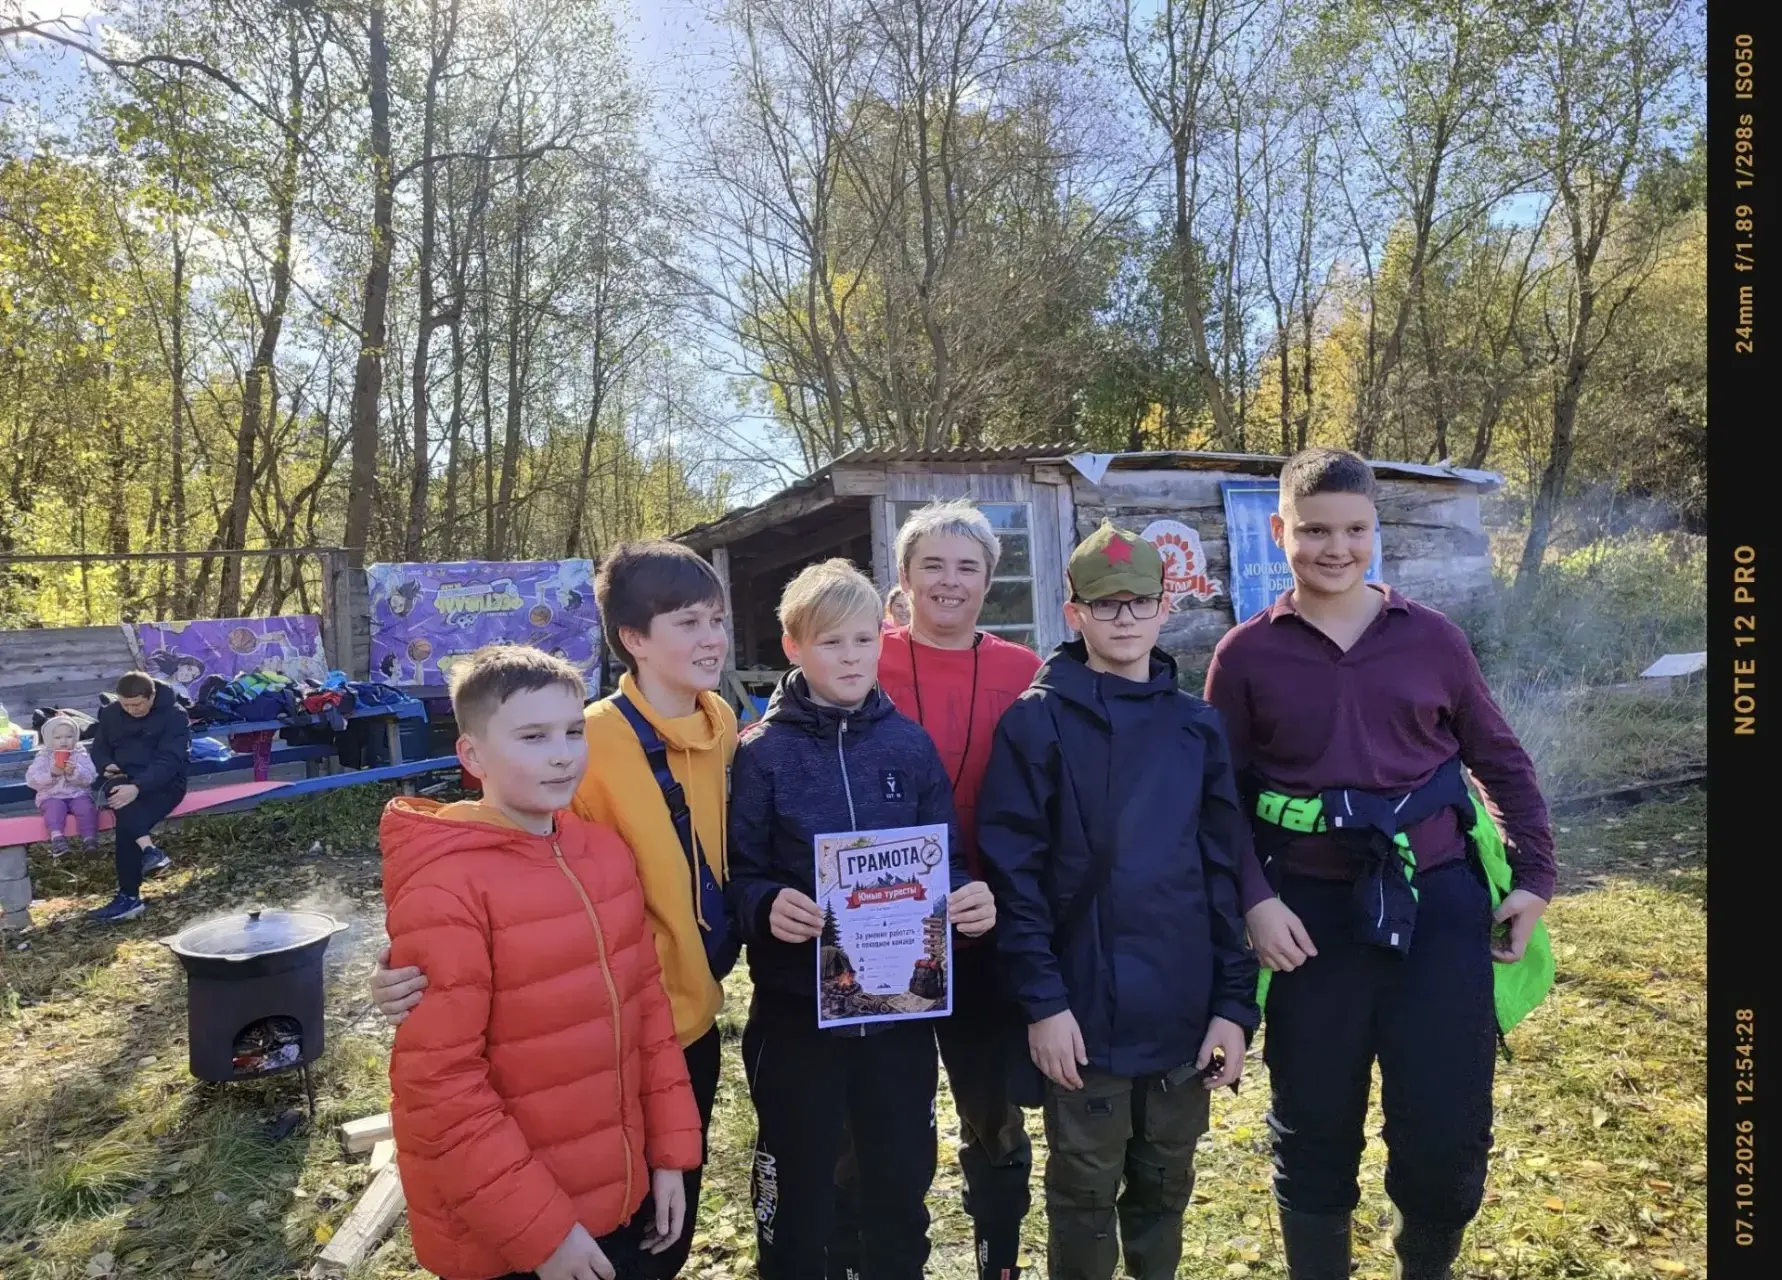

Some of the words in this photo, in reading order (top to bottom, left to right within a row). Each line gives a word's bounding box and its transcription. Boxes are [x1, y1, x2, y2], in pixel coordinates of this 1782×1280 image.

[846, 846, 921, 876] ГРАМОТА
[858, 891, 883, 902] Юные
[885, 886, 917, 900] туристы
